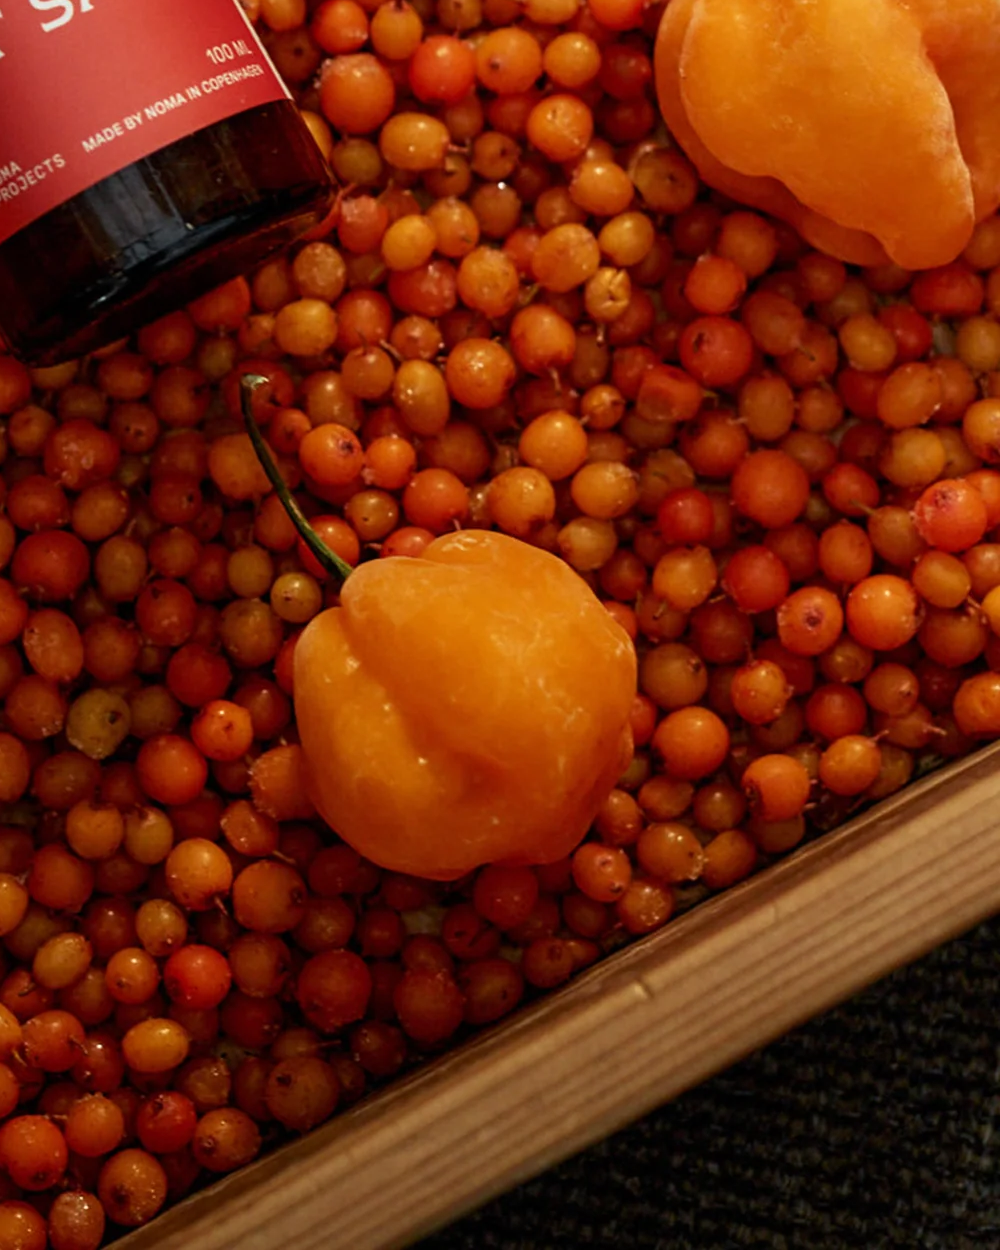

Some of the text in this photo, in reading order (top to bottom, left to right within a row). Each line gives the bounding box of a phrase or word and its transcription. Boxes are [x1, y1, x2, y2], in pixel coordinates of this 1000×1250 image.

[206, 40, 252, 65] 100 ML
[81, 64, 264, 153] MADE BY NOMA IN COPENHAGEN
